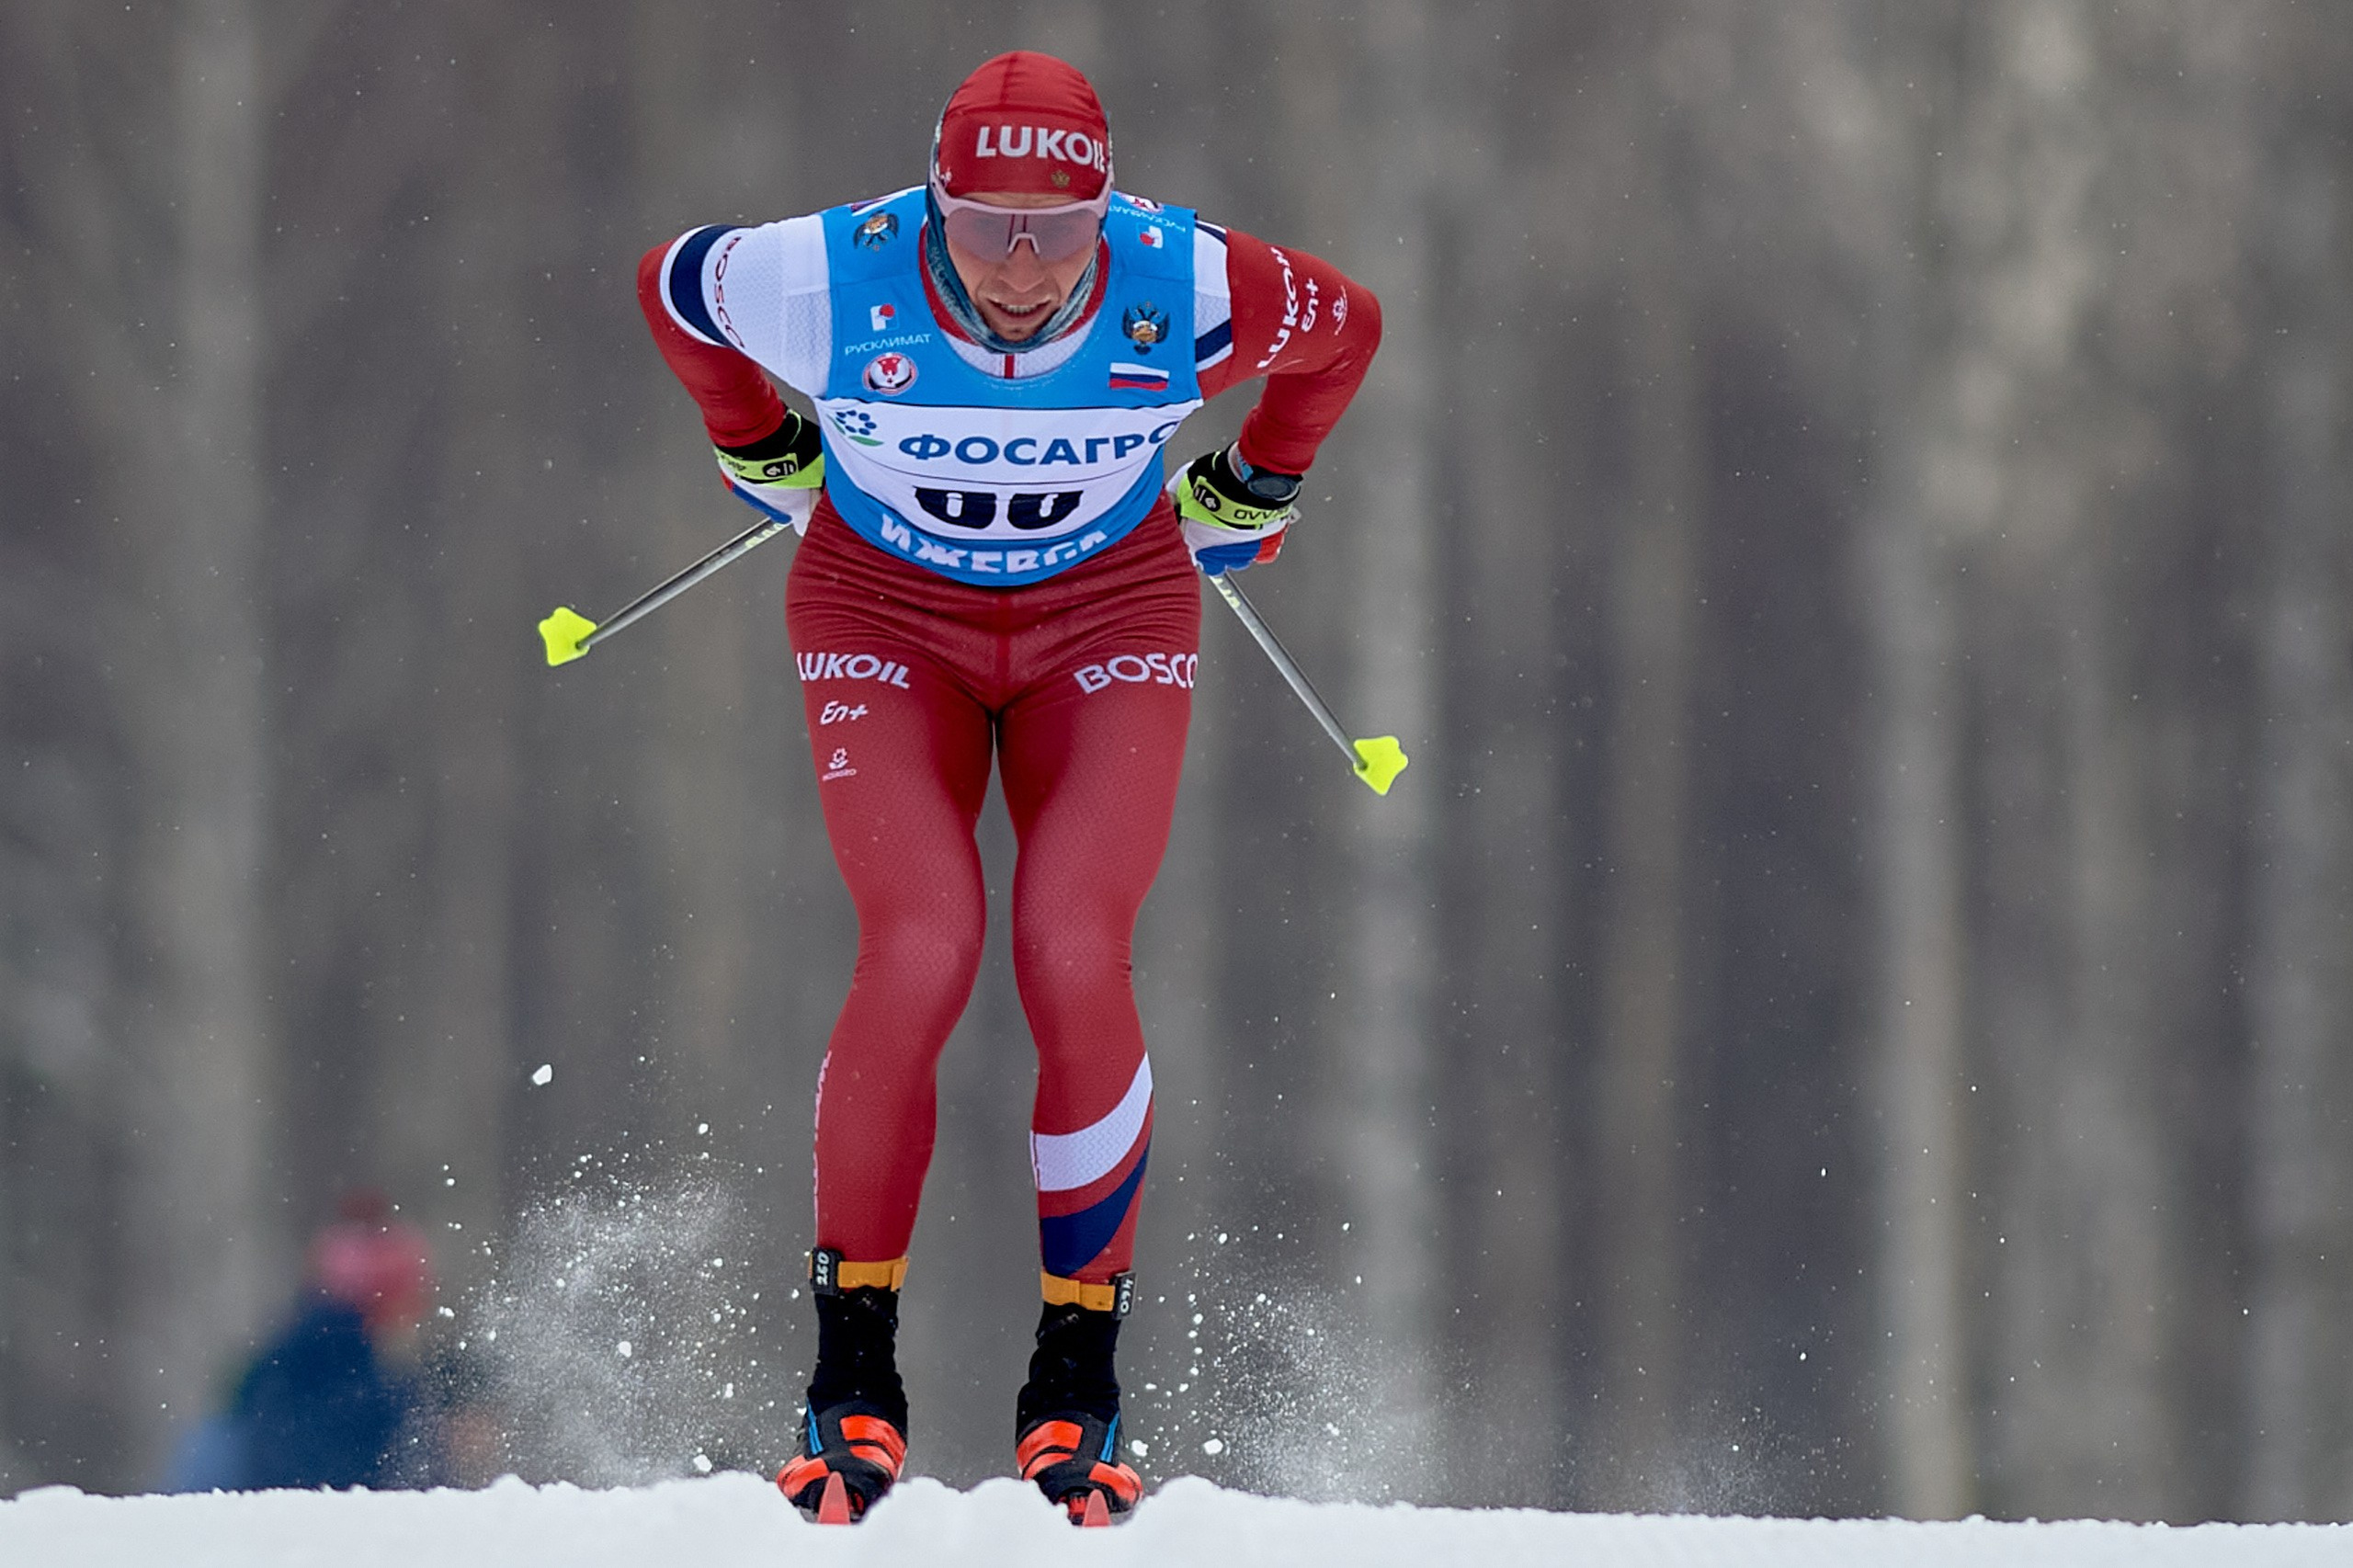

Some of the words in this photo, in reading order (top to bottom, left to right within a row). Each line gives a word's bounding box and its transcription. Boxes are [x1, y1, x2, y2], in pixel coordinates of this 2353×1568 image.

[975, 125, 1106, 175] LUKOIL
[844, 333, 932, 356] РУСКЛИМАТ
[796, 652, 911, 689] LUKOIL
[1073, 653, 1199, 695] BOSCO
